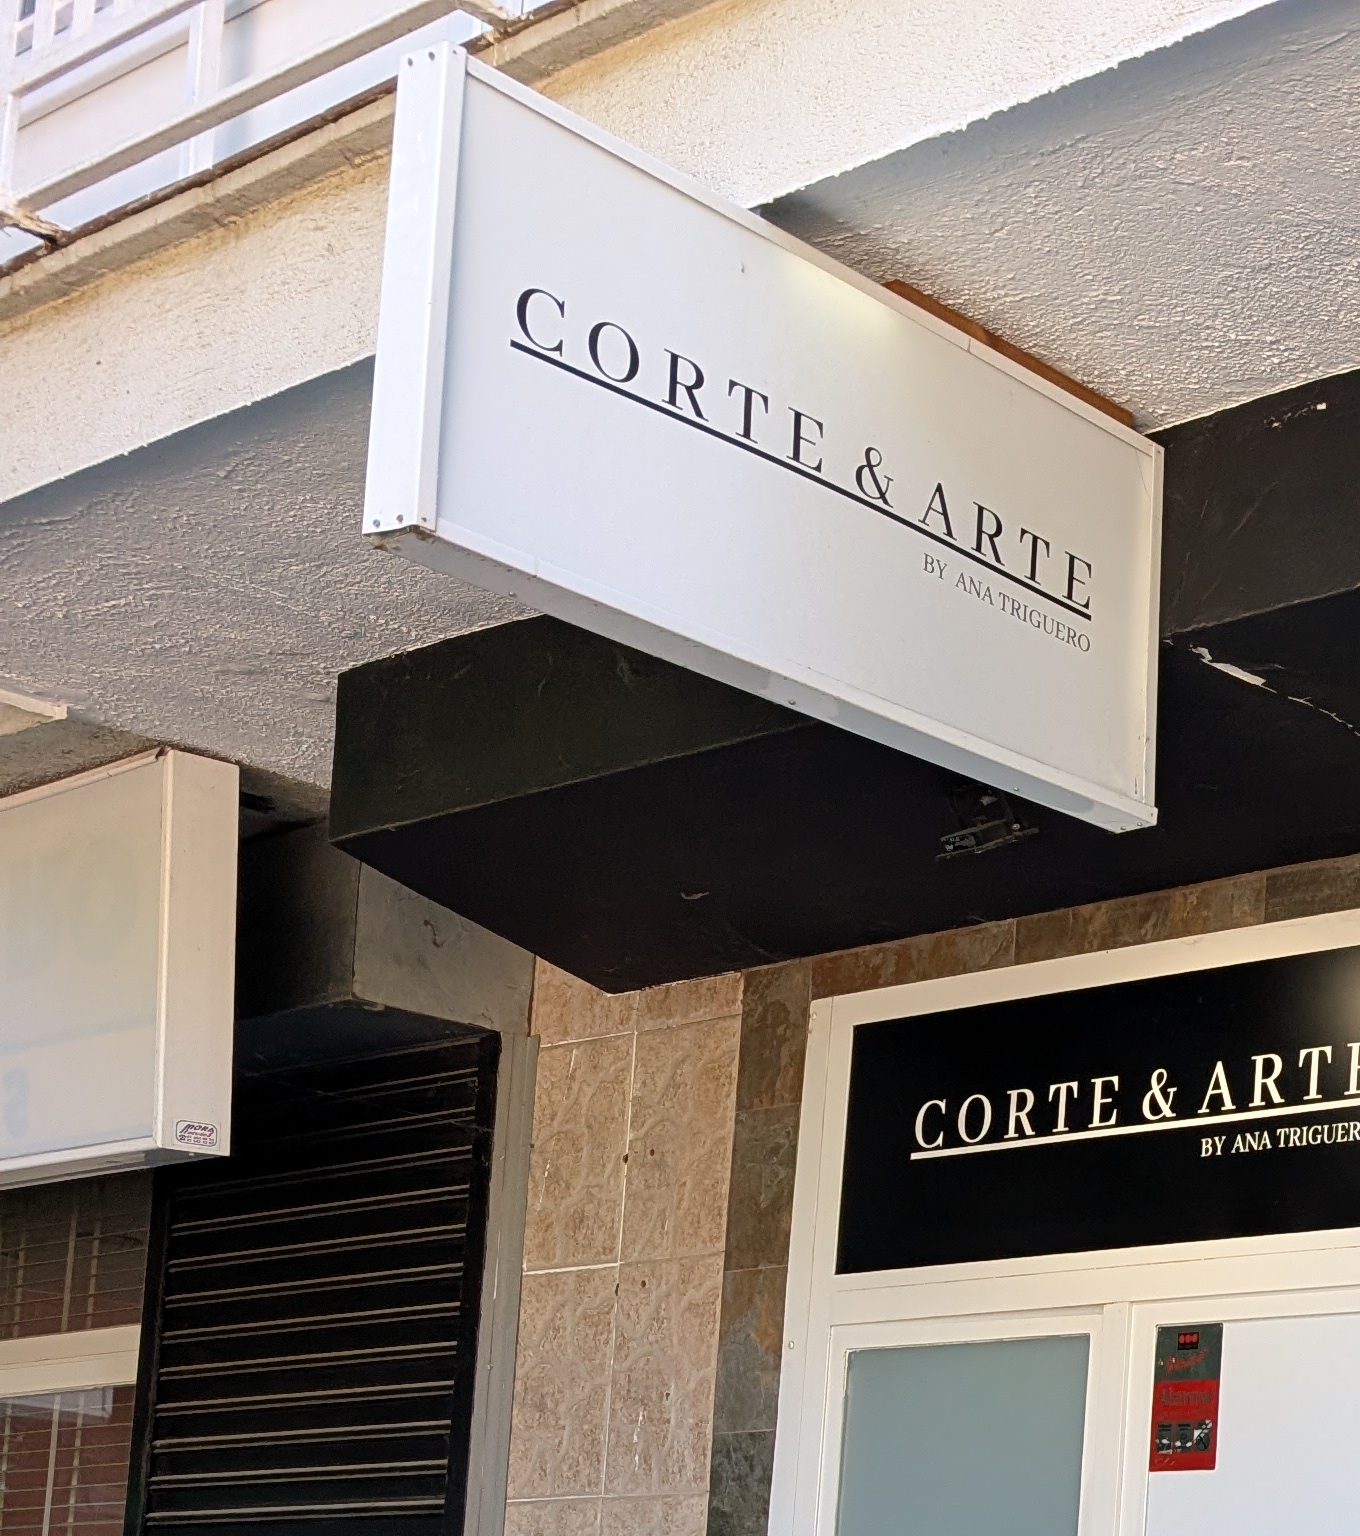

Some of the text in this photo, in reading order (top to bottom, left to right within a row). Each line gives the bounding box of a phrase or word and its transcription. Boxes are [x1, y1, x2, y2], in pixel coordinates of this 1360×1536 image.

[516, 287, 1092, 609] CORTE & ARTE
[923, 552, 1091, 653] BY ANA TRIGUERO
[914, 1075, 1120, 1148] CORTE
[1141, 1068, 1177, 1120] &
[1200, 1136, 1226, 1157] BY
[1231, 1130, 1272, 1154] ANA
